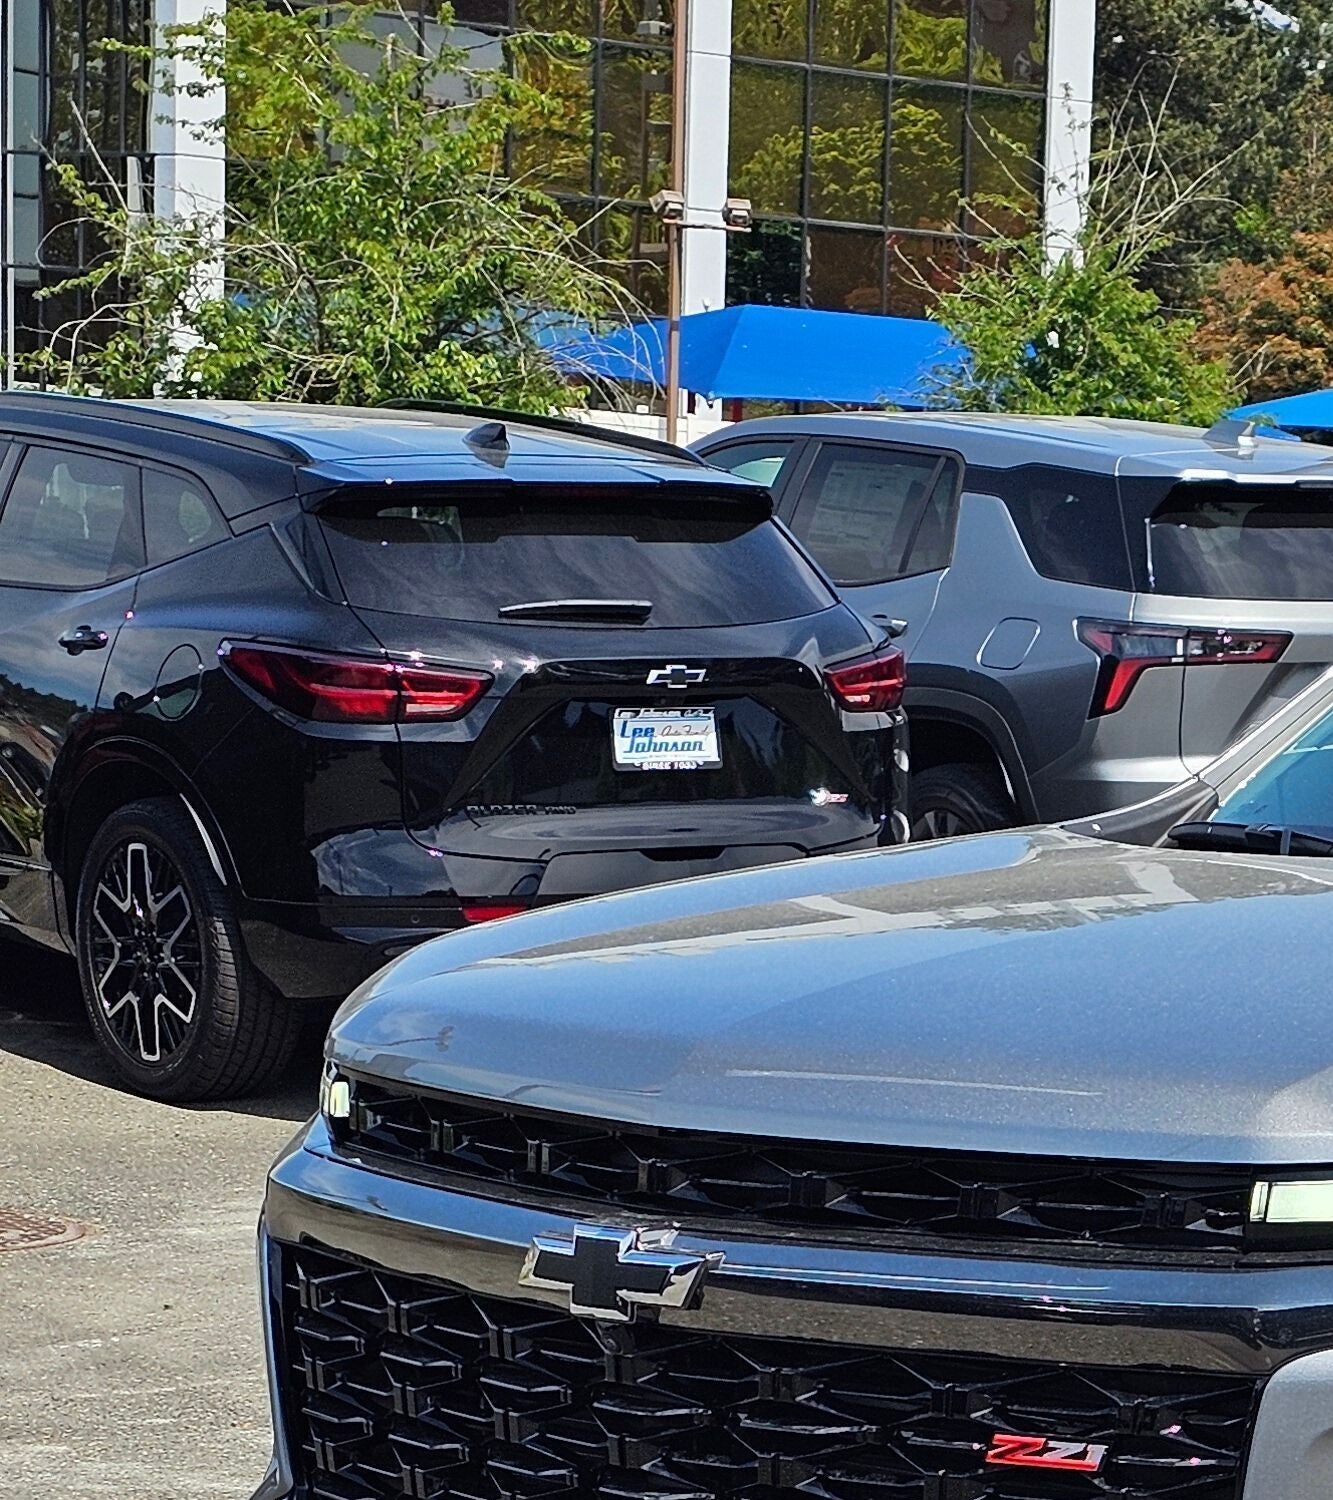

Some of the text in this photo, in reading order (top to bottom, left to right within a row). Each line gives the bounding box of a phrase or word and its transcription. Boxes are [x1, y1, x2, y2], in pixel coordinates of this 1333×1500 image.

[620, 720, 655, 738] Lee
[623, 736, 705, 754] Johnson
[466, 804, 537, 817] BLAZER
[984, 1433, 1110, 1472] Z71
